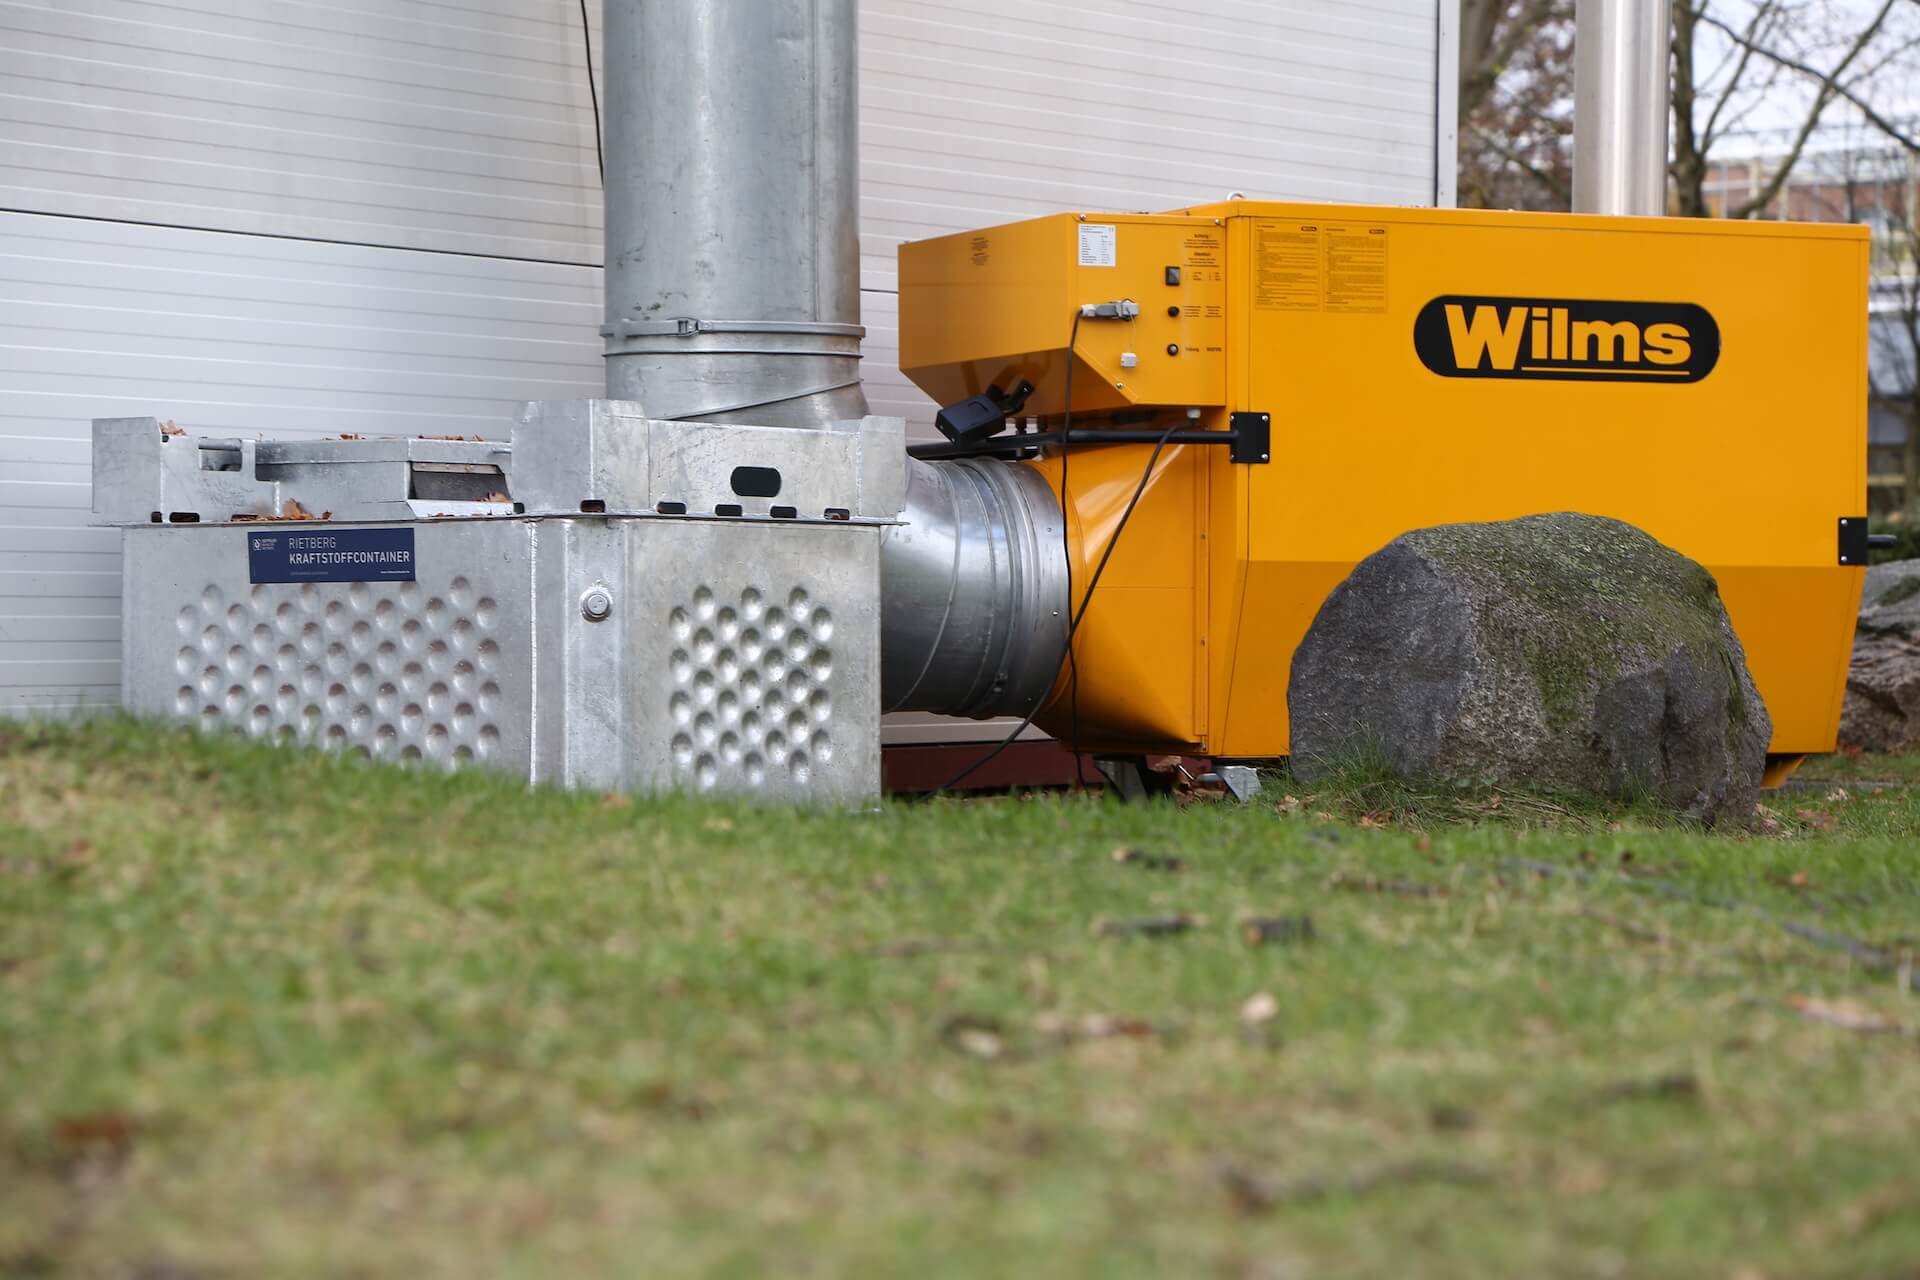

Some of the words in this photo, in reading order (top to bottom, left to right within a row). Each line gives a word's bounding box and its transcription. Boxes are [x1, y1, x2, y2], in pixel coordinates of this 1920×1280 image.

[1444, 304, 1692, 371] Wilms
[288, 537, 337, 549] RIETBERG
[289, 551, 411, 564] KRAFTSTOFFCONTAINER
